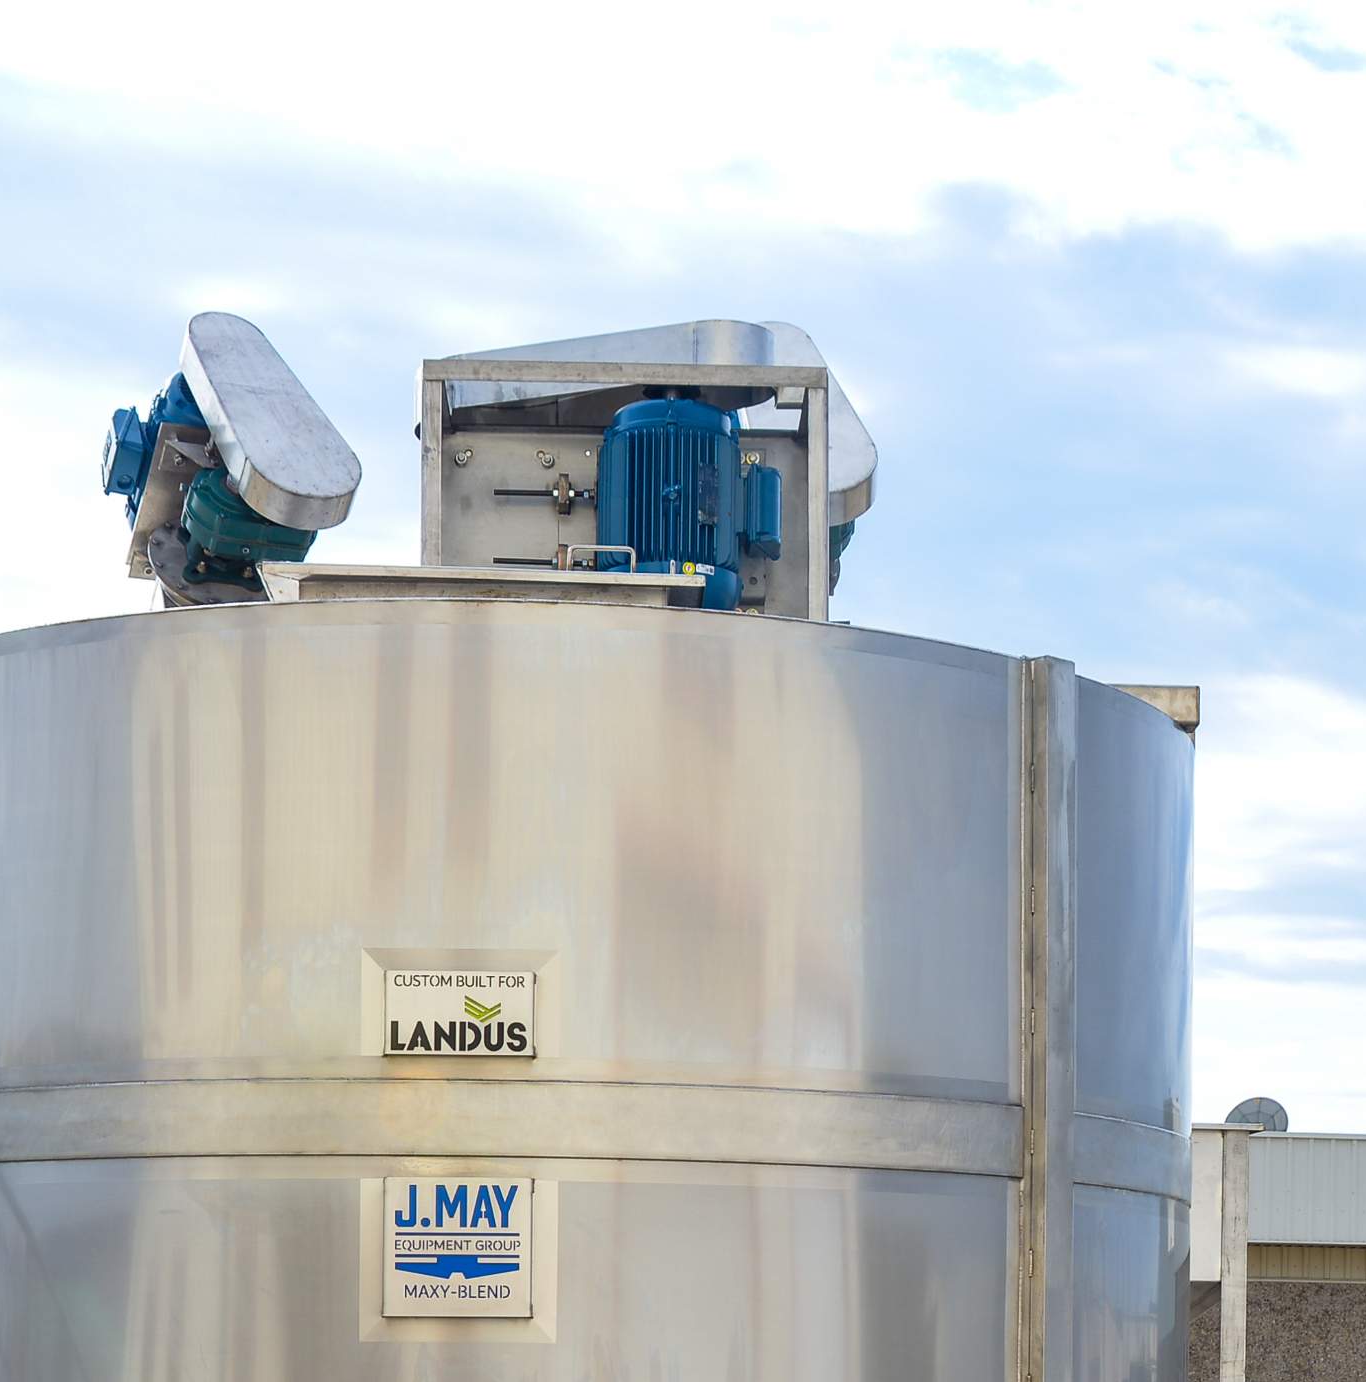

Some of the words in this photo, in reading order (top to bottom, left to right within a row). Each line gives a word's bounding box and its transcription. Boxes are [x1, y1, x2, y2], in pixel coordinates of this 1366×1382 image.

[393, 974, 453, 988] CUSTOM
[456, 975, 496, 988] BUILT
[498, 976, 525, 988] FOR
[390, 1020, 528, 1052] LANDUS
[394, 1184, 519, 1229] J.MAY
[394, 1239, 472, 1252] EQUIPMENT
[475, 1240, 521, 1252] GROUP
[404, 1284, 511, 1300] MAXY-BLEND
